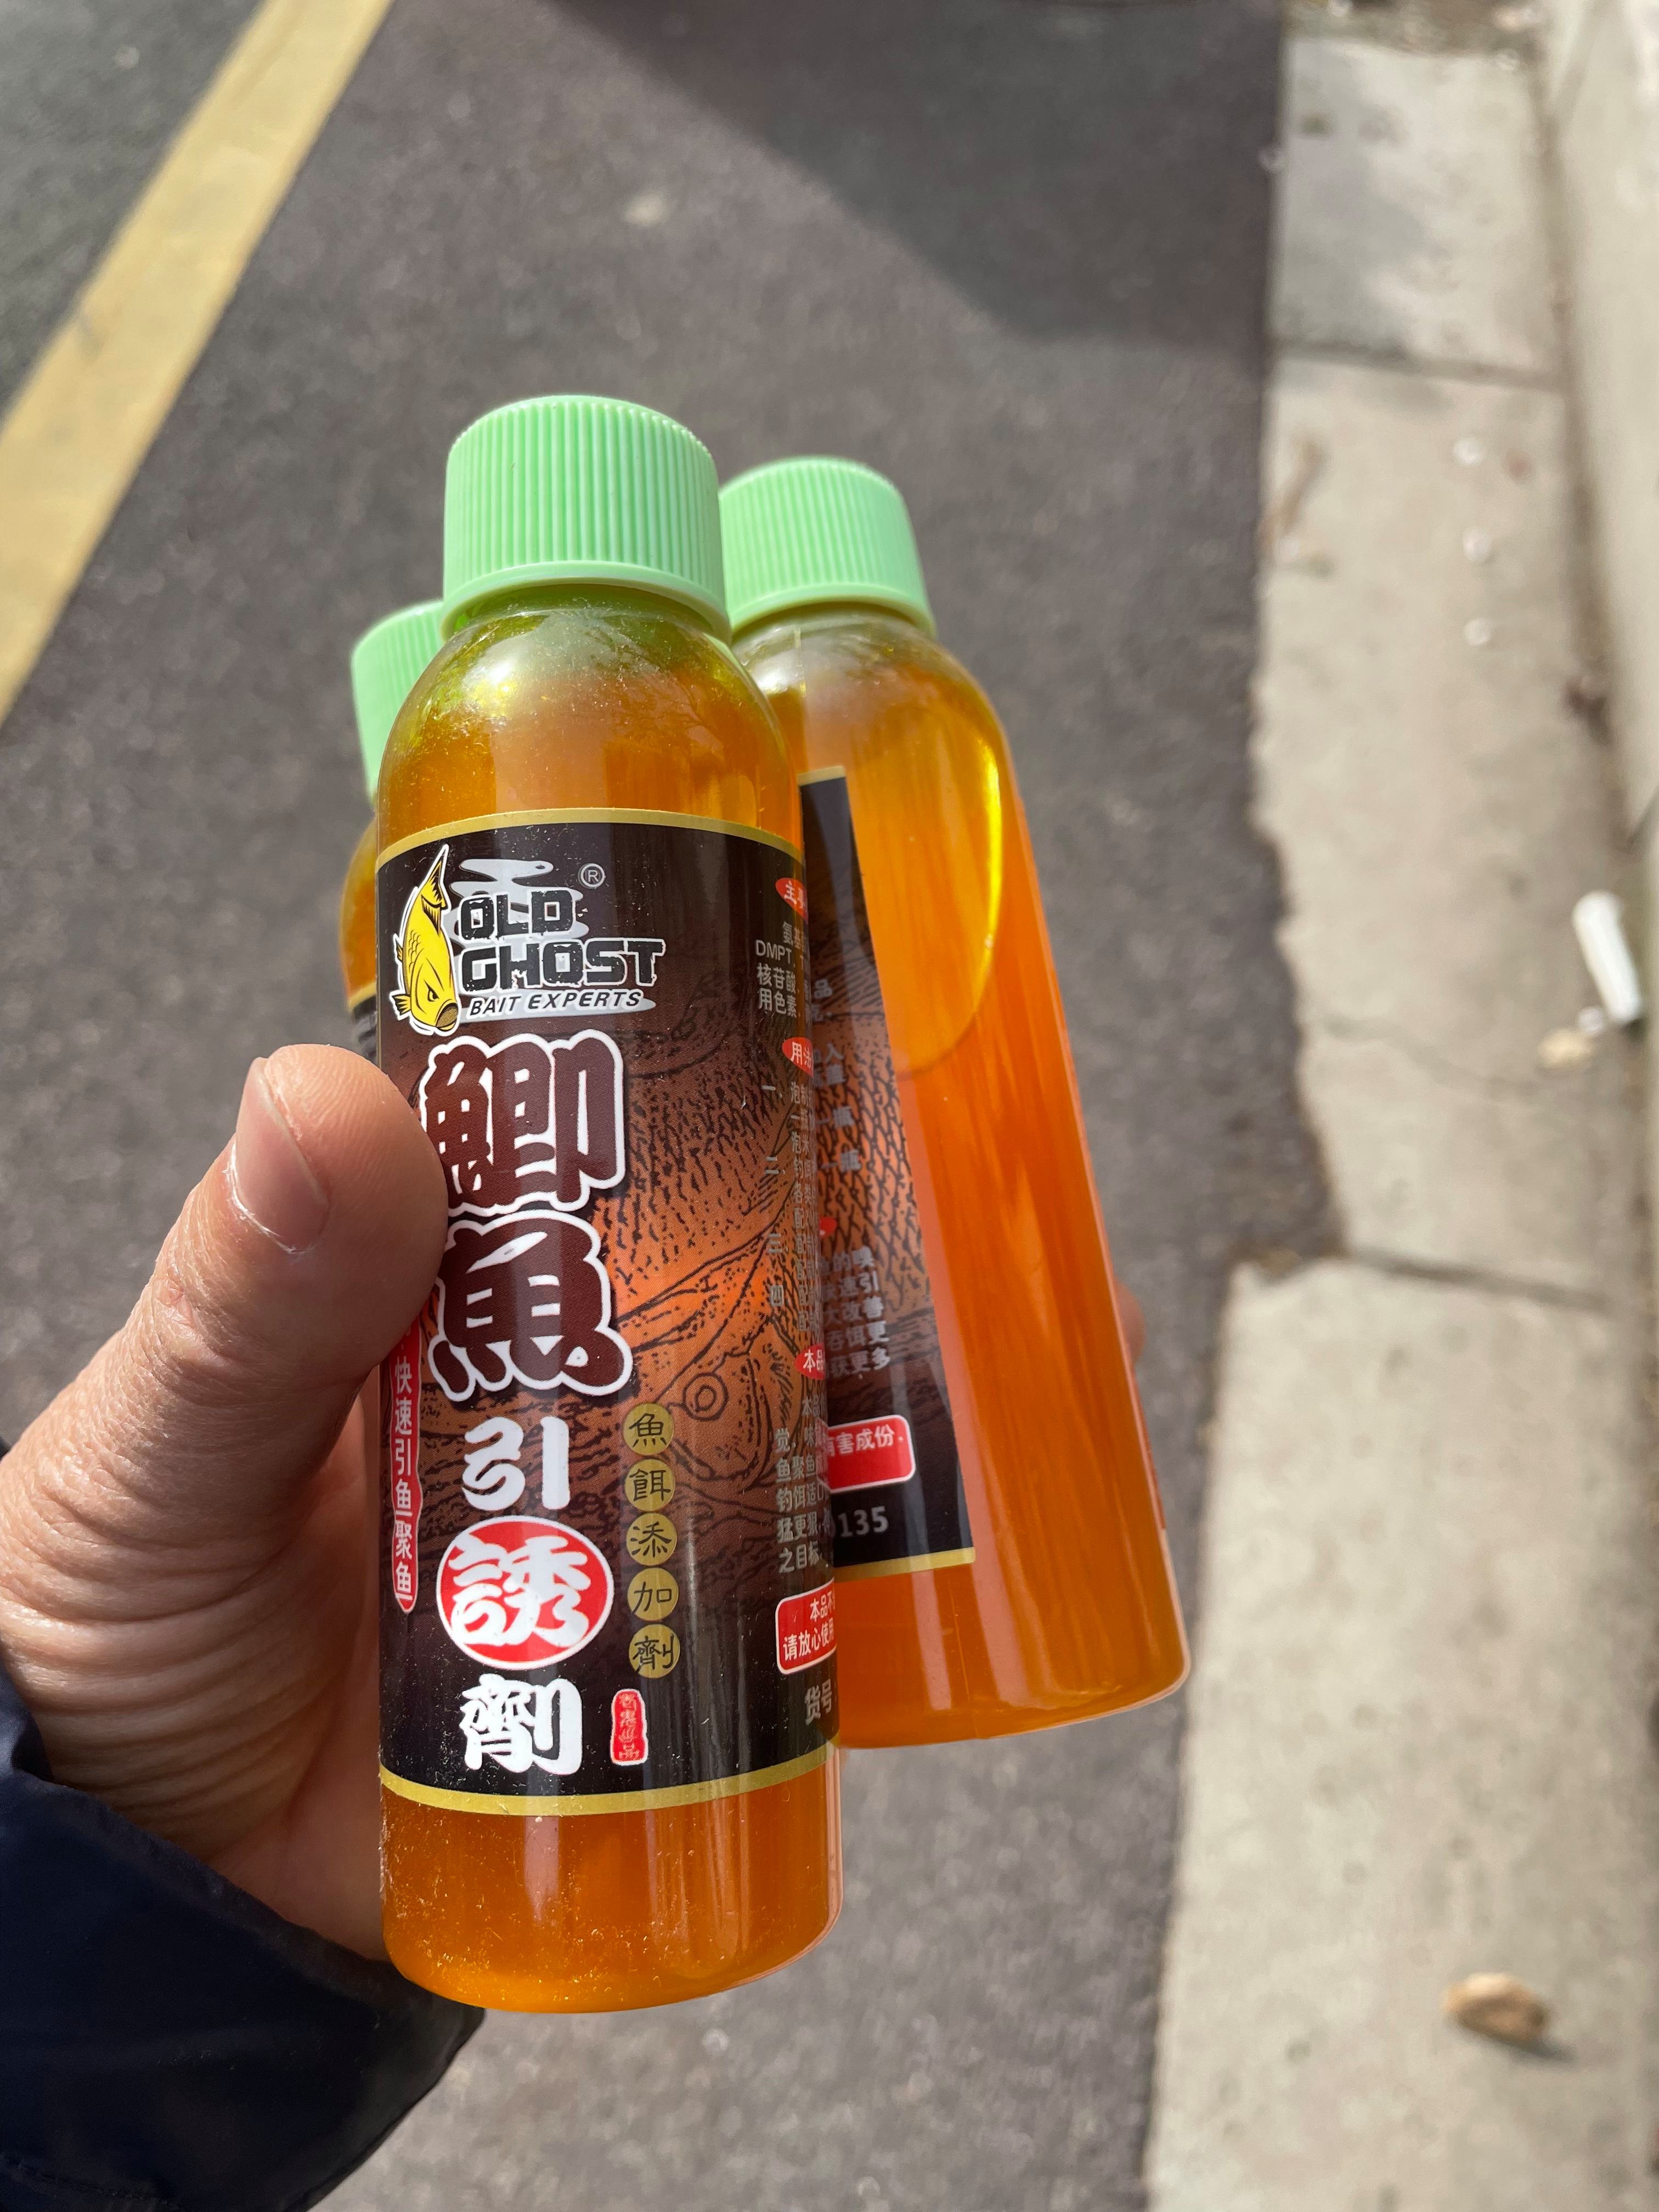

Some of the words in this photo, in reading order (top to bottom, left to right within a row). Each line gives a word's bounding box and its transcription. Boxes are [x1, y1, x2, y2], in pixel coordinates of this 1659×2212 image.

[459, 888, 575, 941] OLD
[460, 938, 665, 994] GHOST
[470, 995, 521, 1016] BAIT
[528, 991, 641, 1010] EXPERTS
[394, 1356, 413, 1602] 快速引鱼聚鱼
[628, 1413, 674, 1674] 魚餌添加劑
